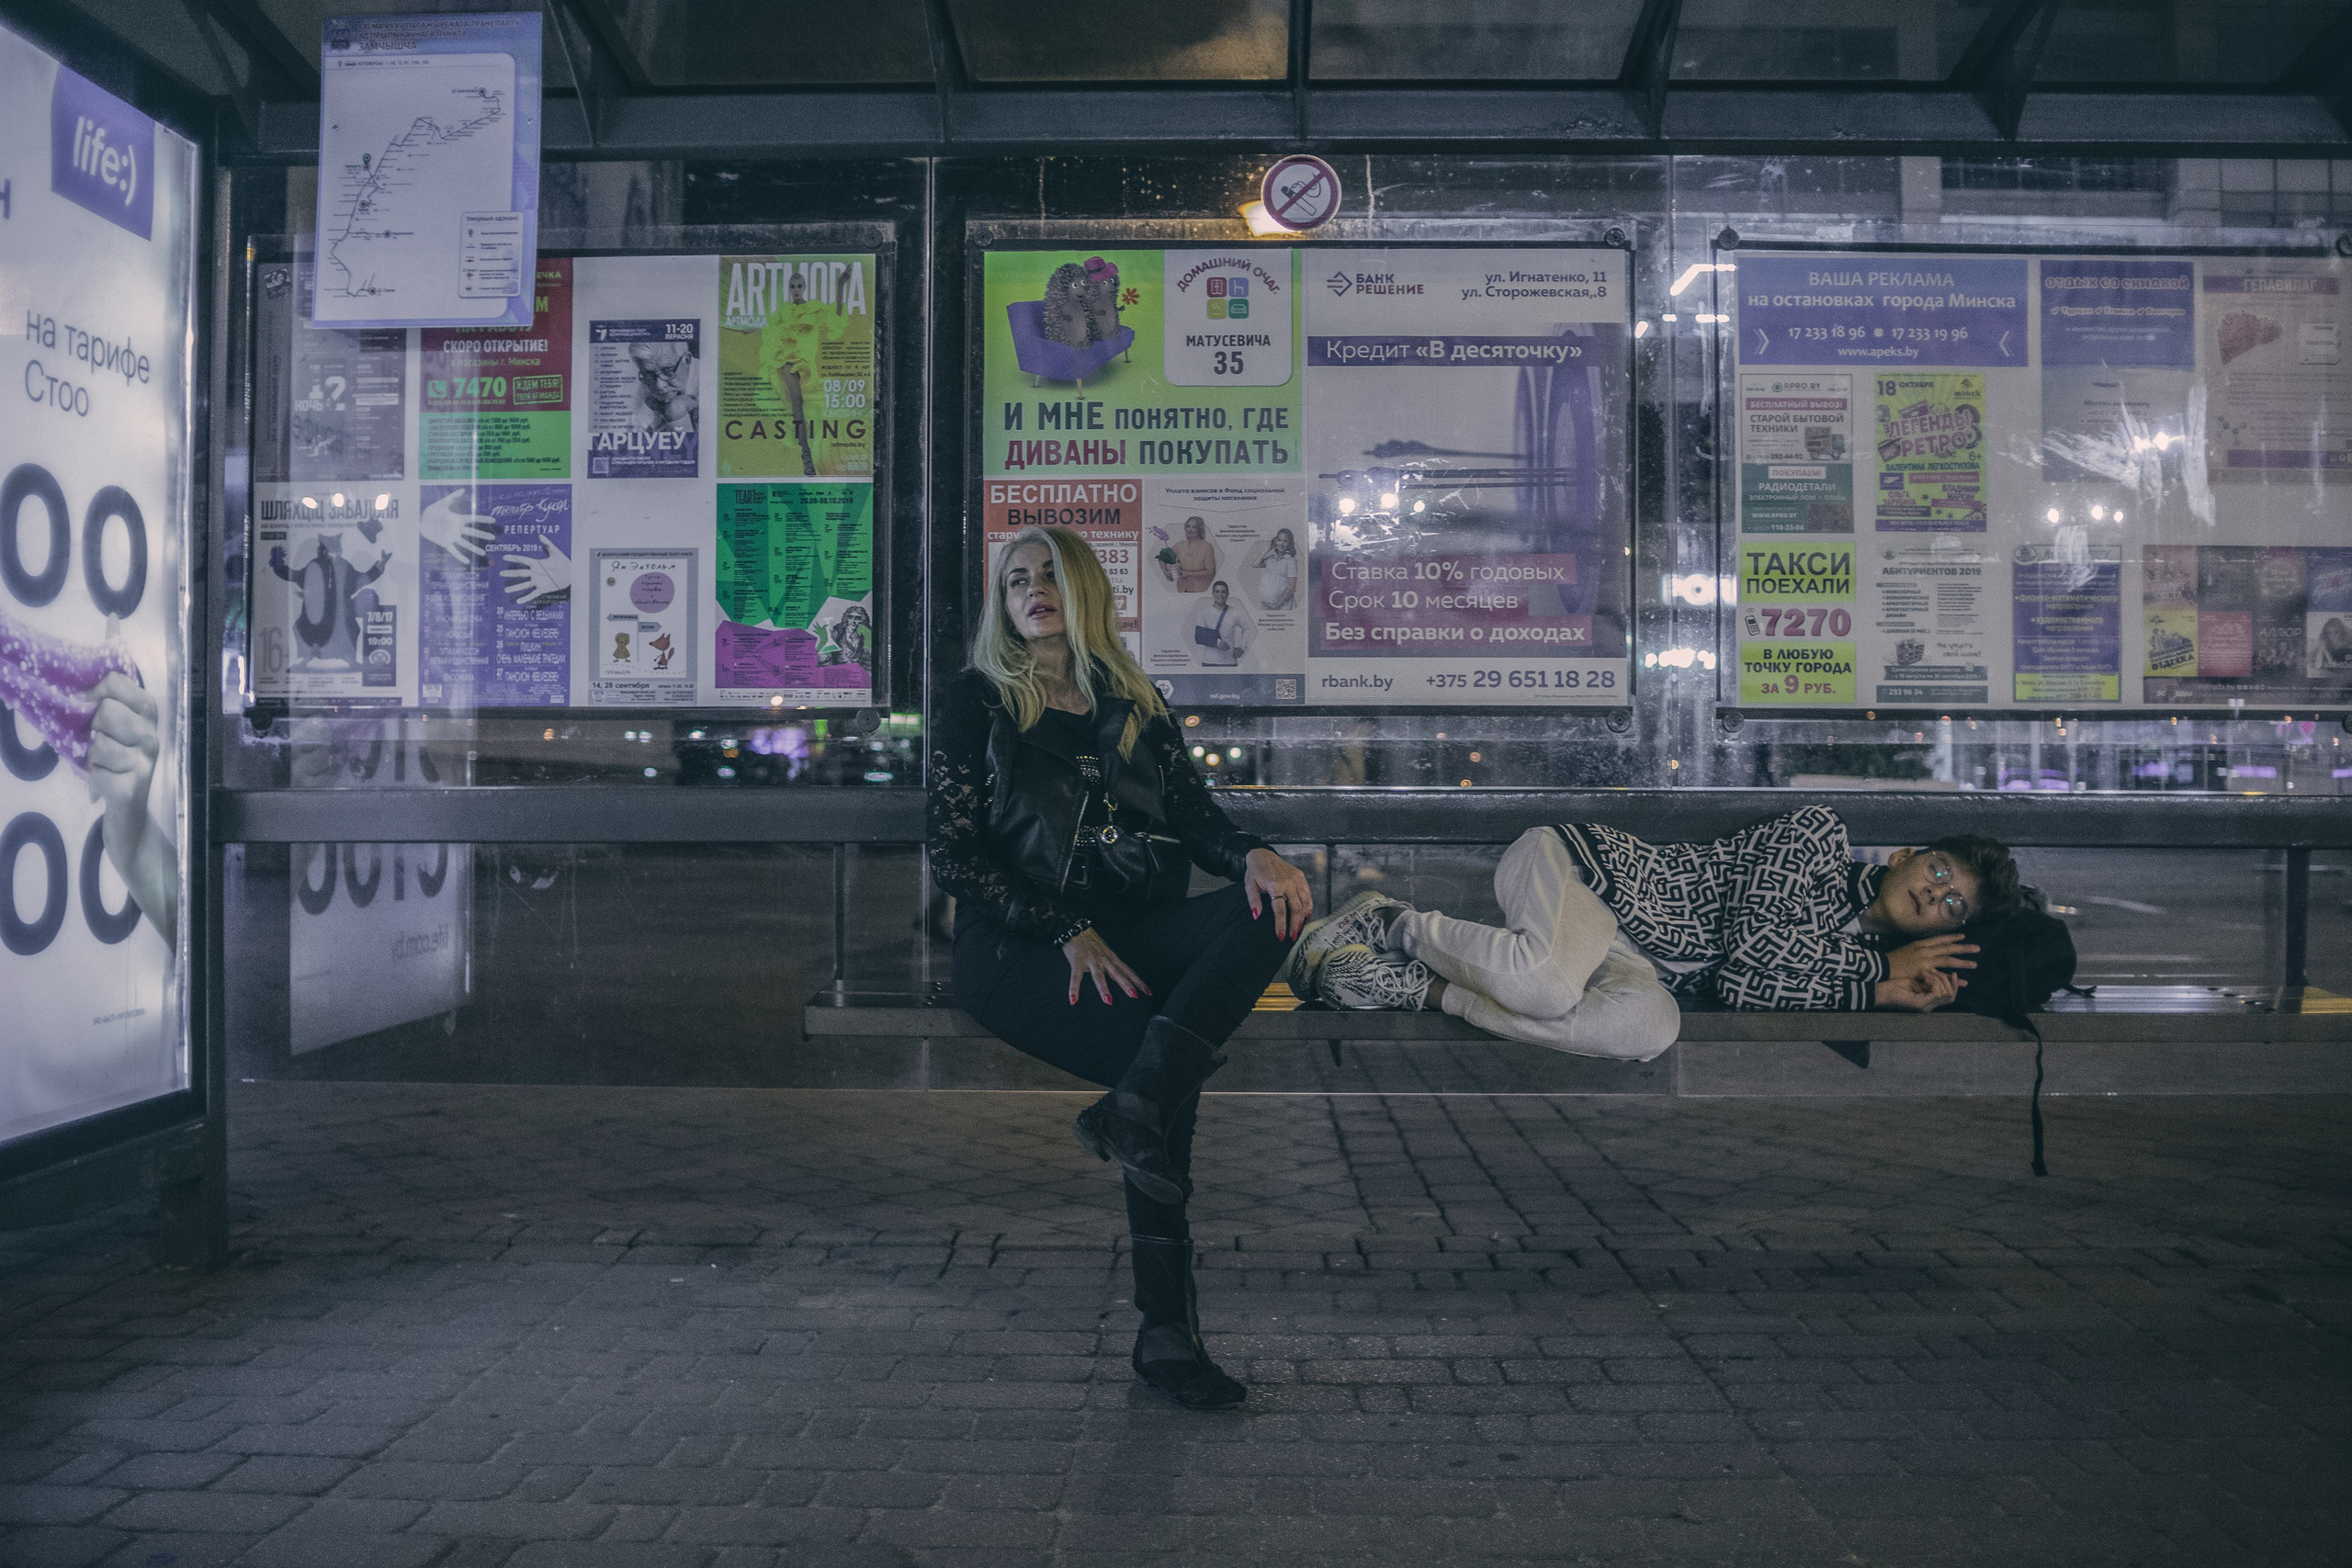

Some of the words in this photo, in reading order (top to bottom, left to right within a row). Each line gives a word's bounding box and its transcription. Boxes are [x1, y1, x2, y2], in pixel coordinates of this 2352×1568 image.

[73, 116, 137, 207] life:)
[1176, 257, 1251, 293] ДОМАШНИЙ
[1253, 266, 1280, 295] ОЧАГ
[1355, 274, 1395, 284] БАНК
[1485, 273, 1506, 284] ул.
[1510, 271, 1589, 284] Игнатенко,
[1593, 272, 1607, 282] 11
[1809, 272, 1863, 287] ВАША
[1869, 272, 1955, 288] РЕКЛАМА
[2045, 276, 2098, 289] ОТДЫХ
[2099, 276, 2120, 289] СО
[727, 262, 866, 315] ARTMODA
[1355, 285, 1424, 295] РЕШЕНИЕ
[1462, 288, 1482, 299] ул.
[1486, 286, 1593, 299] Сторожевская,
[1598, 287, 1607, 298] 8
[1748, 296, 1769, 307] на
[1773, 296, 1874, 307] остановках
[1883, 297, 1945, 311] города
[1949, 294, 2016, 308] Минска
[666, 324, 694, 333] 11-20
[1788, 327, 1801, 339] 17
[1804, 327, 1828, 340] 233
[1831, 326, 1845, 338] 18
[1849, 326, 1866, 339] 96
[1892, 327, 1905, 339] 17
[1908, 327, 1930, 341] 233
[1934, 327, 1948, 341] 19
[1951, 327, 1969, 340] 96
[27, 310, 56, 349] на
[64, 323, 150, 387] тарифе
[443, 340, 481, 353] СКОРО
[483, 339, 548, 353] ОТКРЫТИЕ!
[1186, 334, 1271, 347] МАТУСЕВИЧА
[1327, 341, 1410, 362] Кредит
[1416, 341, 1445, 358] «В
[1451, 344, 1583, 363] десяточку»
[1838, 346, 1919, 358] www.apeks.by
[1214, 351, 1244, 375] 35
[25, 360, 89, 417] Стоо
[452, 377, 506, 398] 7470
[823, 378, 865, 394] 08/09
[1877, 380, 1896, 396] 18
[824, 394, 865, 409] 15:00
[1750, 400, 1808, 409] БЕСПЛАТНЫЙ
[1003, 402, 1023, 431] И
[1038, 402, 1104, 430] МНЕ
[1114, 407, 1233, 432] ПОНЯТНО,
[1242, 407, 1289, 433] ГДЕ
[1750, 412, 1791, 423] СТАРОЙ
[1792, 412, 1844, 423] БЫТОВОЙ
[725, 419, 866, 440] CASTING
[1902, 432, 1966, 457] РЕТРО
[1004, 439, 1126, 470] ДИВАНЫ
[1139, 439, 1289, 465] ПОКУПАТЬ
[989, 483, 1137, 504] БЕСПЛАТНО
[1758, 482, 1836, 492] РАДИОДЕТАЛИ
[1008, 508, 1121, 525] ВЫВОЗИМ
[504, 525, 560, 534] РЕПЕРТУАР
[988, 532, 1021, 541] стару
[1091, 531, 1139, 541] технику
[485, 544, 522, 552] СЕНТЯБРЬ
[1095, 549, 1129, 564] 383
[1747, 552, 1850, 576] ТАКСИ
[1332, 562, 1408, 580] Ставка
[1415, 561, 1464, 581] 10%
[1470, 567, 1565, 583] годовых
[1959, 567, 1982, 575] 2019
[1113, 585, 1134, 595] ti.by
[1746, 579, 1850, 594] ПОЕХАЛИ
[1329, 591, 1385, 612] Срок
[1391, 591, 1419, 608] 10
[1426, 595, 1519, 612] месяцев
[1761, 608, 1851, 637] 7270
[1325, 623, 1365, 640] Без
[1371, 627, 1464, 646] справки
[1471, 627, 1485, 641] о
[1489, 627, 1585, 645] доходах
[1763, 649, 1772, 660] В
[1775, 649, 1833, 660] ЛЮБУЮ
[1745, 662, 1792, 672] ТОЧКУ
[1796, 662, 1851, 673] ГОРОДА
[615, 682, 650, 690] сентября
[1321, 674, 1394, 691] rbank.by
[1426, 675, 1467, 688] +375
[1473, 671, 1502, 688] 29
[1509, 671, 1548, 688] 651
[1554, 671, 1580, 688] 18
[1586, 671, 1615, 688] 28
[1761, 683, 1779, 694] ЗА
[1784, 674, 1799, 694] 9
[1804, 683, 1836, 694] РУБ.
